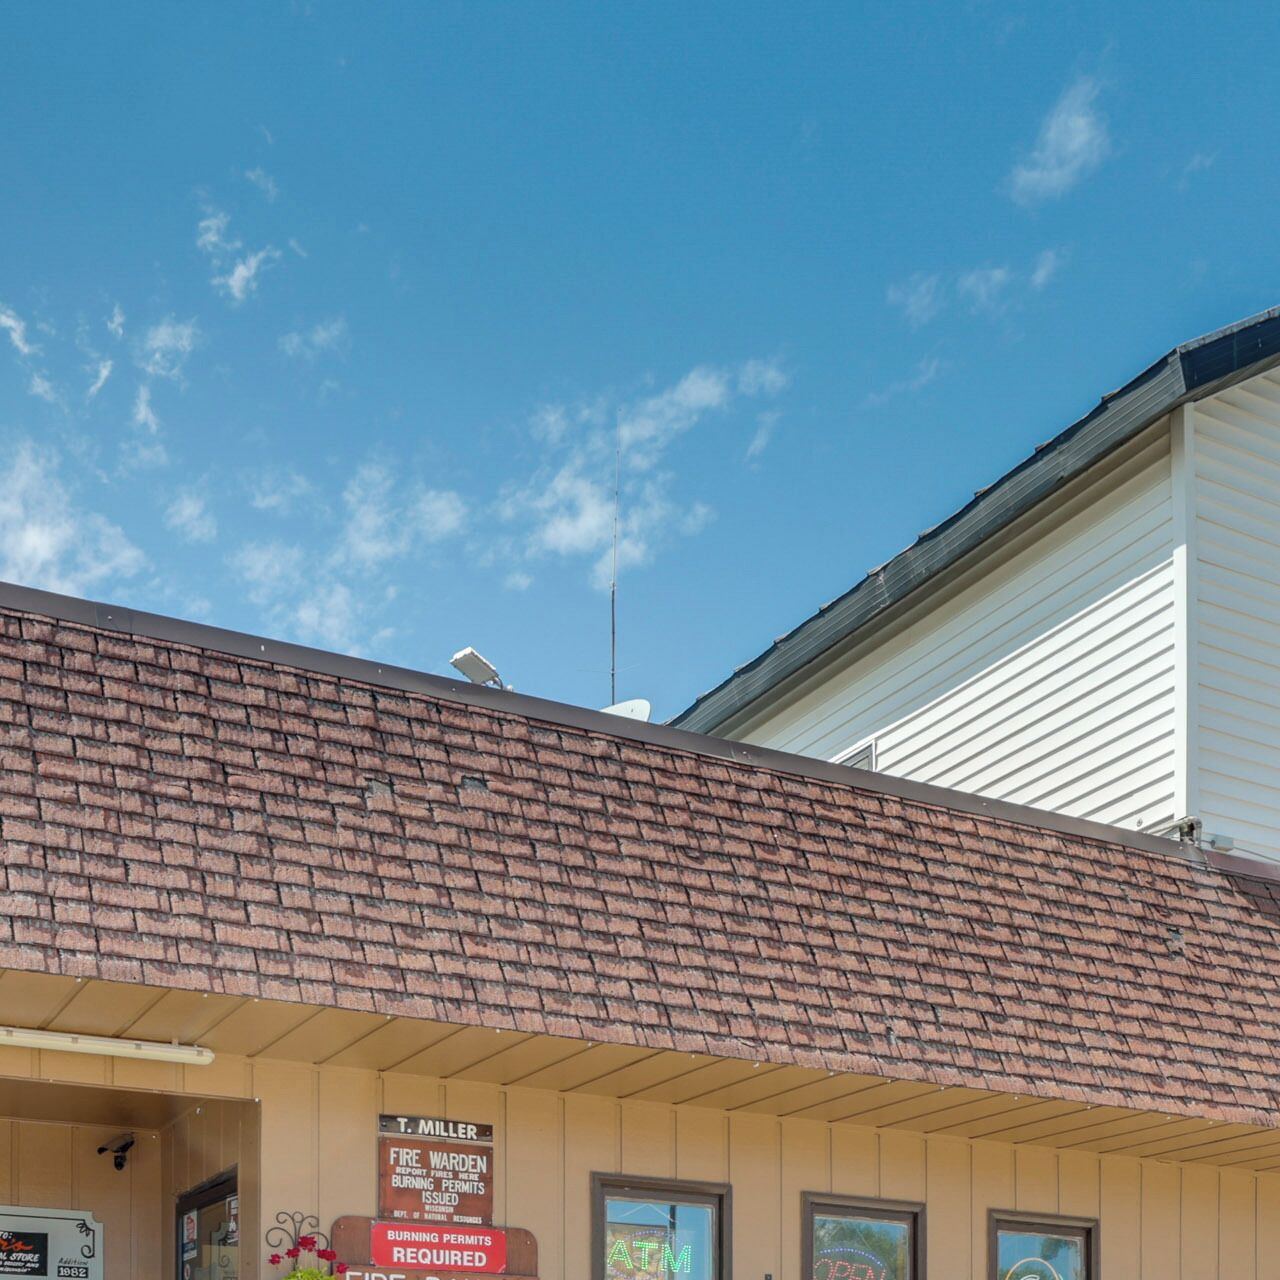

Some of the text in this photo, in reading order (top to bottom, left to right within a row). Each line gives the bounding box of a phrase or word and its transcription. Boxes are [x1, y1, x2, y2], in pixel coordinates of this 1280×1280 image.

[397, 1117, 477, 1140] T. MILLER
[390, 1147, 487, 1173] FIRE WARDEN
[395, 1166, 480, 1181] REPORT FIRES HERE
[392, 1175, 485, 1195] BURNING PERMITS
[422, 1191, 459, 1206] ISSUED
[387, 1230, 492, 1246] BURNING PERMITS
[10, 1253, 40, 1262] STORE
[393, 1247, 487, 1267] REQUIRED
[607, 1239, 691, 1273] ATM
[59, 1267, 87, 1277] 1982
